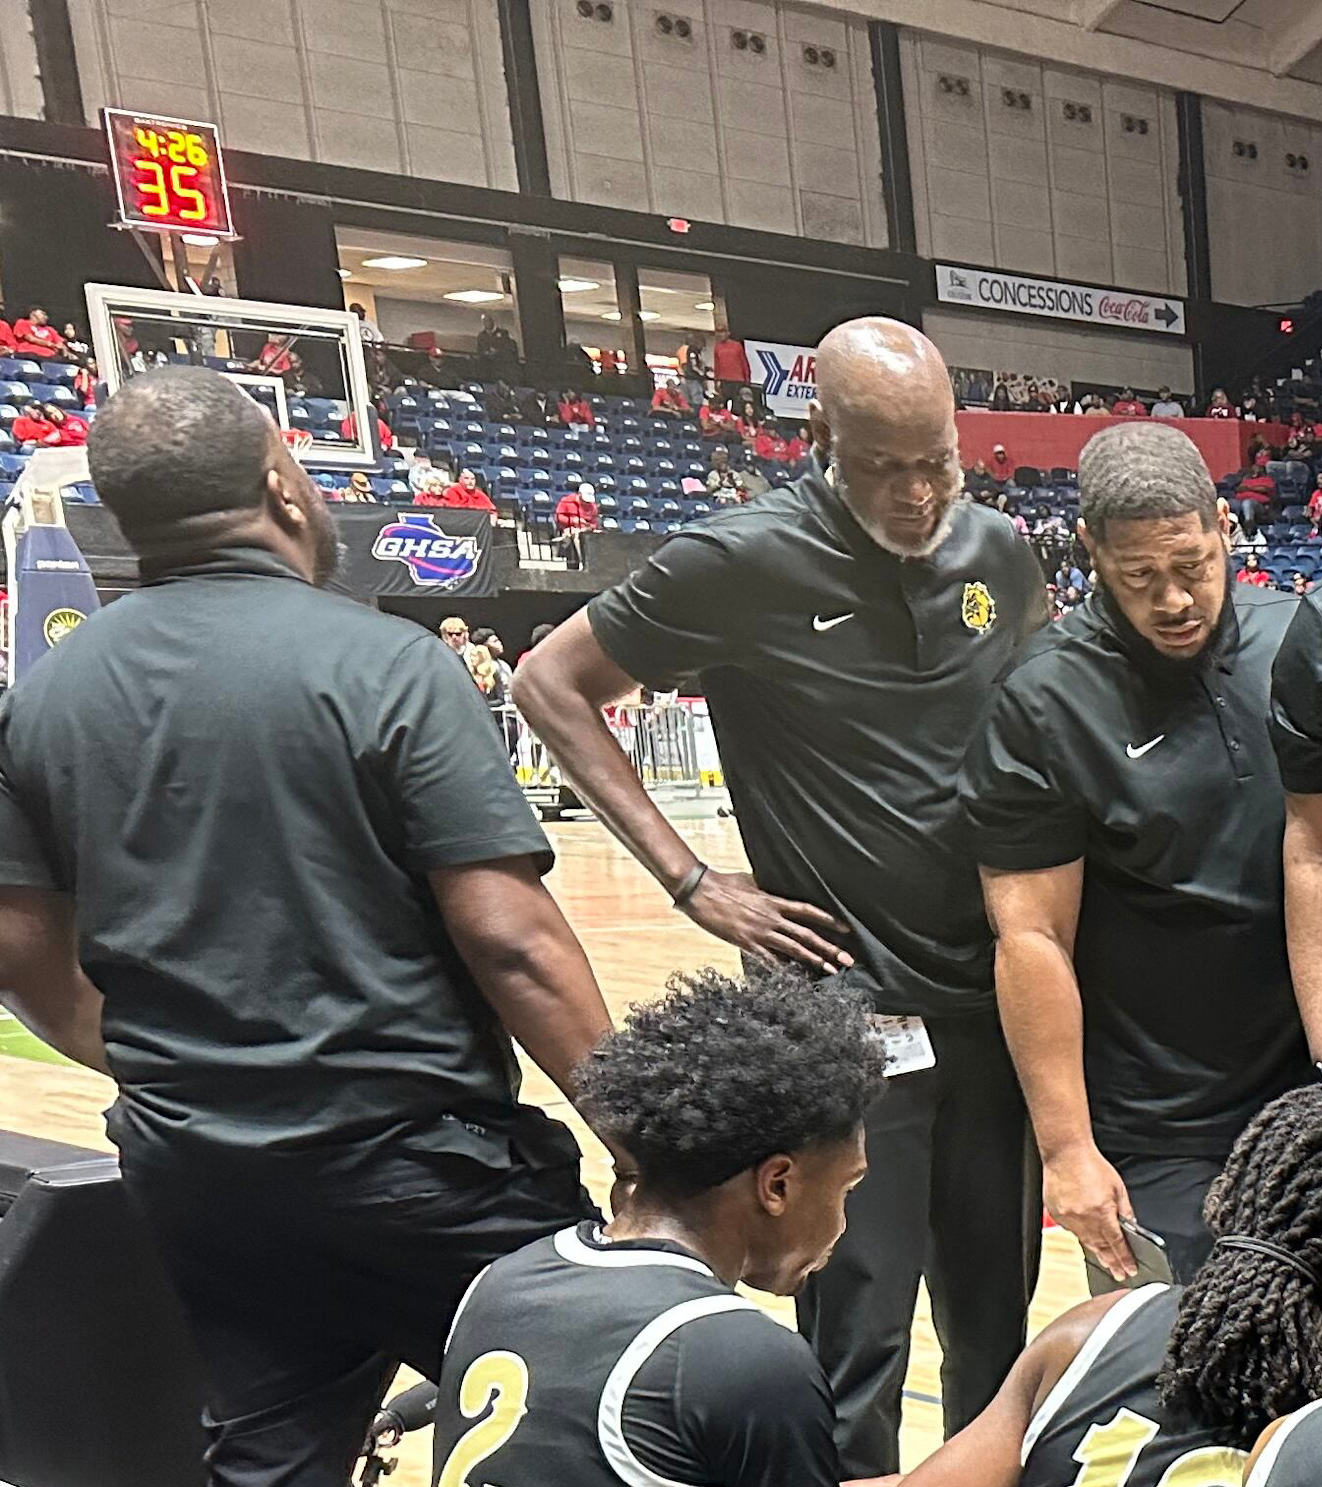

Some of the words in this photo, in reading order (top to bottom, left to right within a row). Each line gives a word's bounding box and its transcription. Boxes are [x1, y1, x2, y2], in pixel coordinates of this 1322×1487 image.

[135, 128, 209, 167] 4:26
[133, 159, 207, 220] 35
[977, 276, 1094, 317] CONCESSIONS
[788, 353, 815, 384] AR
[376, 537, 477, 560] GHSA
